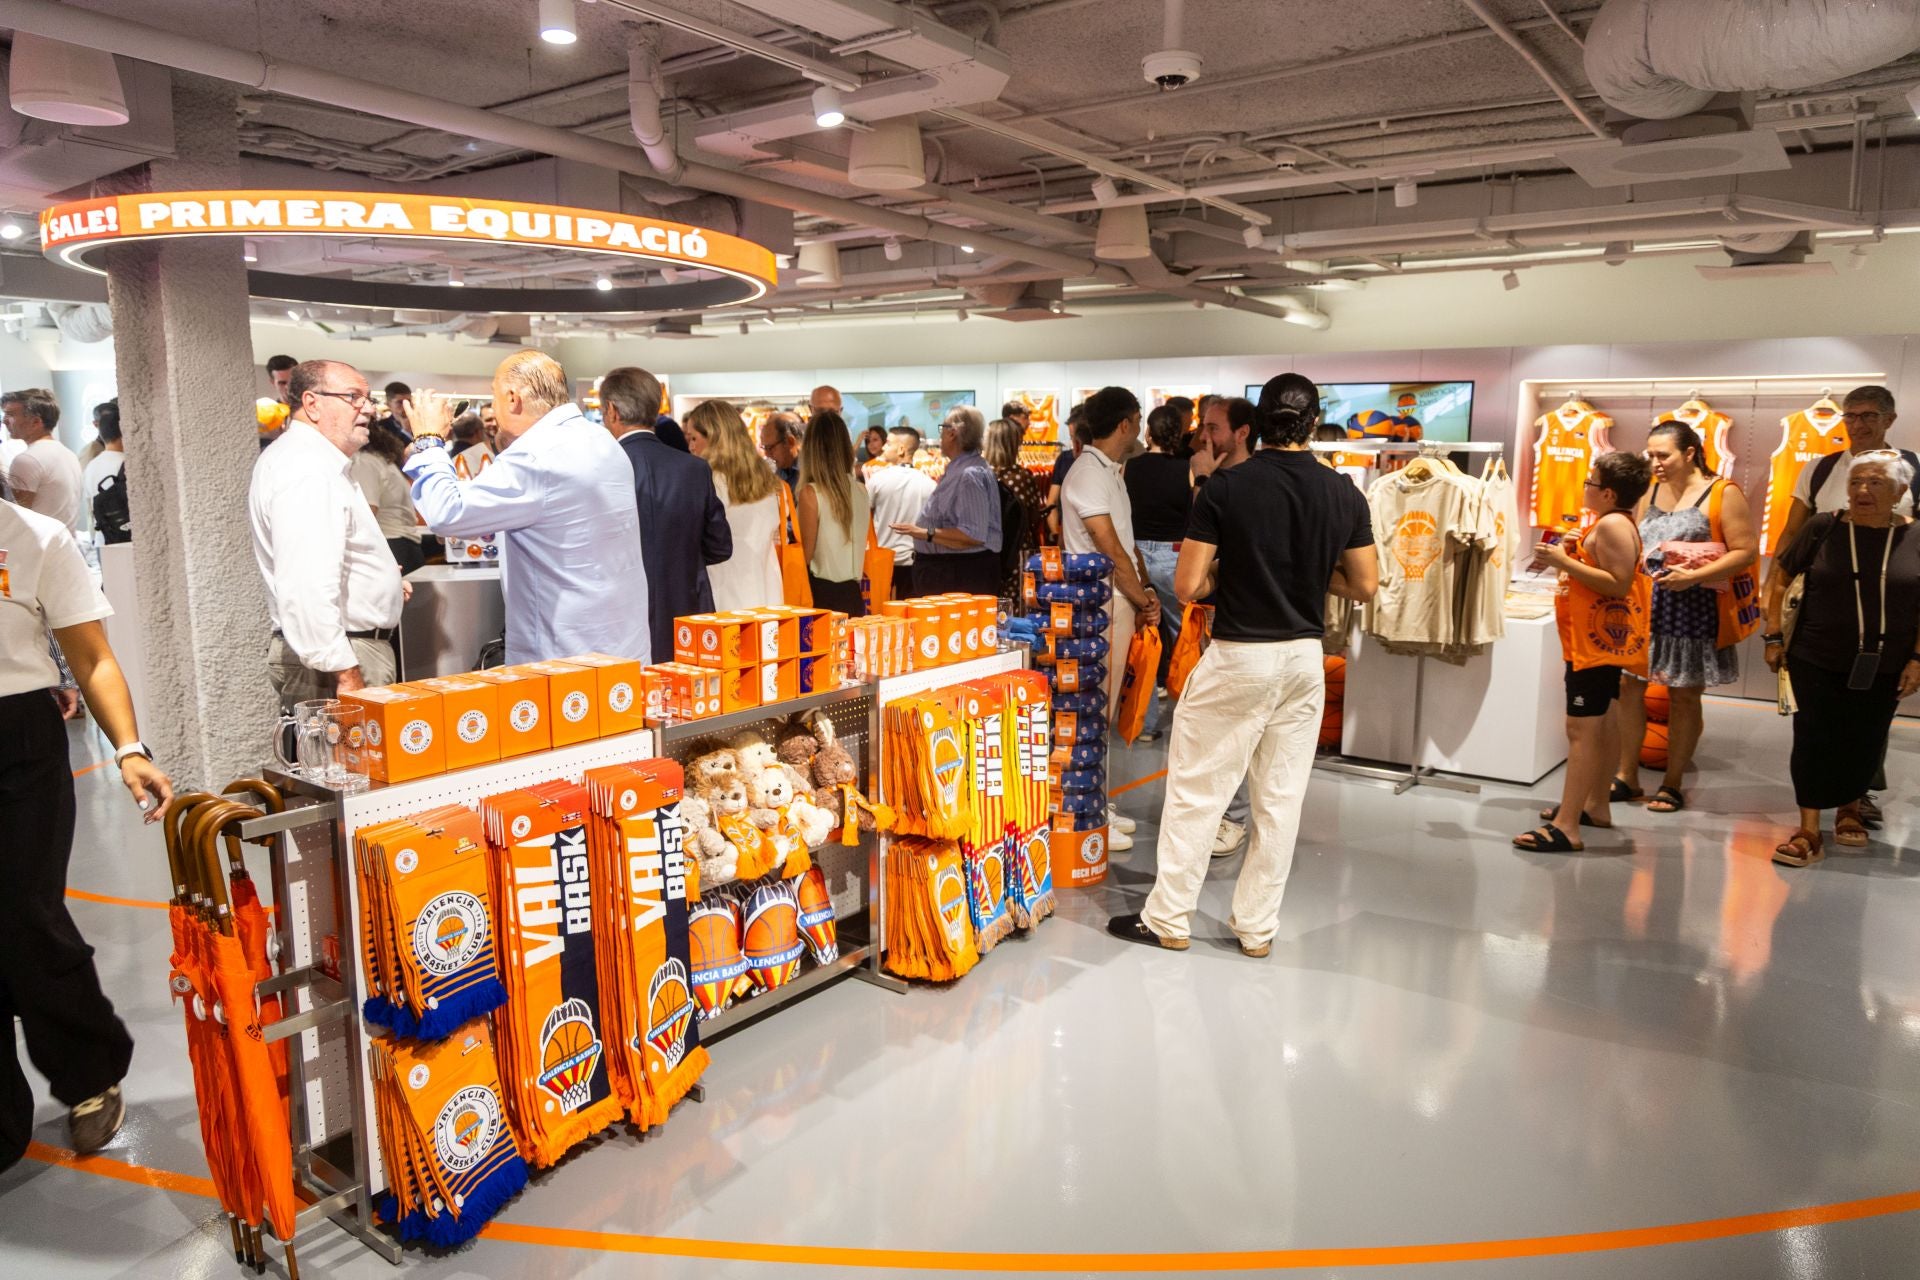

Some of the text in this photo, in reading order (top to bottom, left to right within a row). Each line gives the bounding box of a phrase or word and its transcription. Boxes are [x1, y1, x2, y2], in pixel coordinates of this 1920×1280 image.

[50, 205, 119, 242] SALE!
[138, 199, 708, 259] PRIMERA EQUIPACIÓ
[420, 896, 475, 926] VALENCIA
[423, 952, 459, 971] BASKET
[461, 931, 483, 962] CLUB
[541, 1057, 575, 1083] VALENCIA
[438, 1090, 486, 1131] VALENCIA
[447, 1152, 480, 1168] BASKET
[481, 1118, 498, 1151] CLUB
